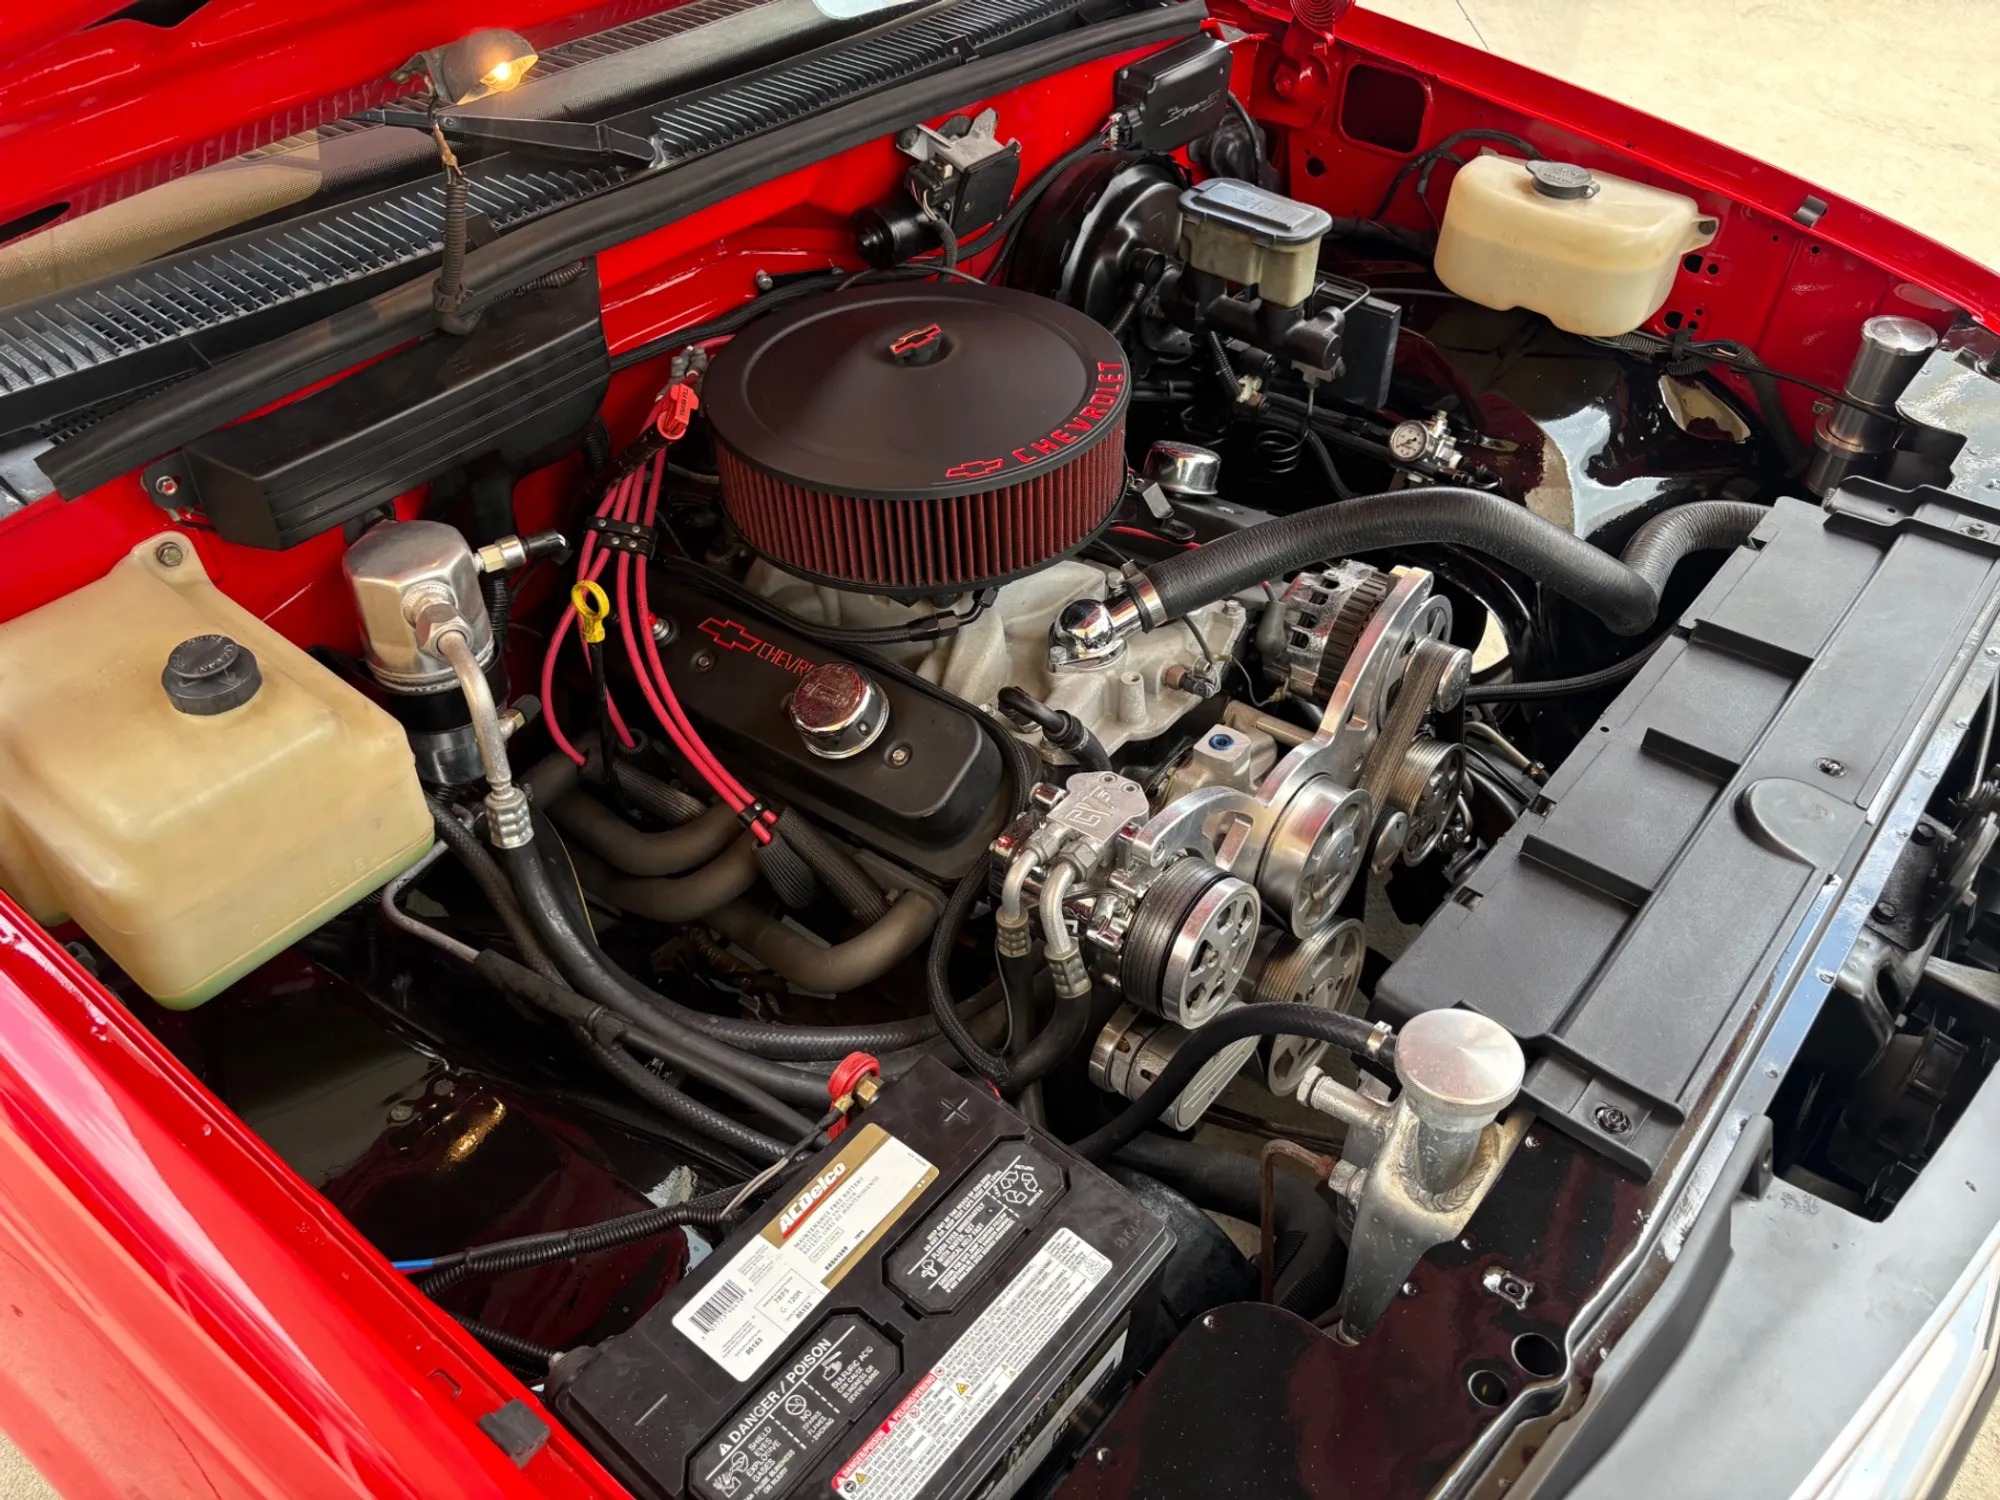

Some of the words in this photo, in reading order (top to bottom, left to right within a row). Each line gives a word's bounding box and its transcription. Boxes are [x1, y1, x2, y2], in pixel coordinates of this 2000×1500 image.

[1012, 361, 1124, 463] CHEVROLET
[778, 1162, 847, 1233] ACDelco
[931, 1241, 947, 1259] FLUSH
[945, 1230, 958, 1244] EYES
[956, 1201, 985, 1232] IMMEDIATELY
[830, 1359, 860, 1389] SULFURIC
[858, 1344, 874, 1361] ACID
[727, 1389, 780, 1444] DANGER
[785, 1336, 831, 1384] POISON
[891, 1374, 935, 1421] PELIGRO/VENENO
[747, 1424, 773, 1451] SHIELD
[799, 1408, 812, 1422] NO
[745, 1439, 782, 1477] EXPLOSIVE
[753, 1436, 773, 1457] EYES
[840, 1428, 886, 1477] DANGER/POISON
[751, 1457, 776, 1483] GASES
